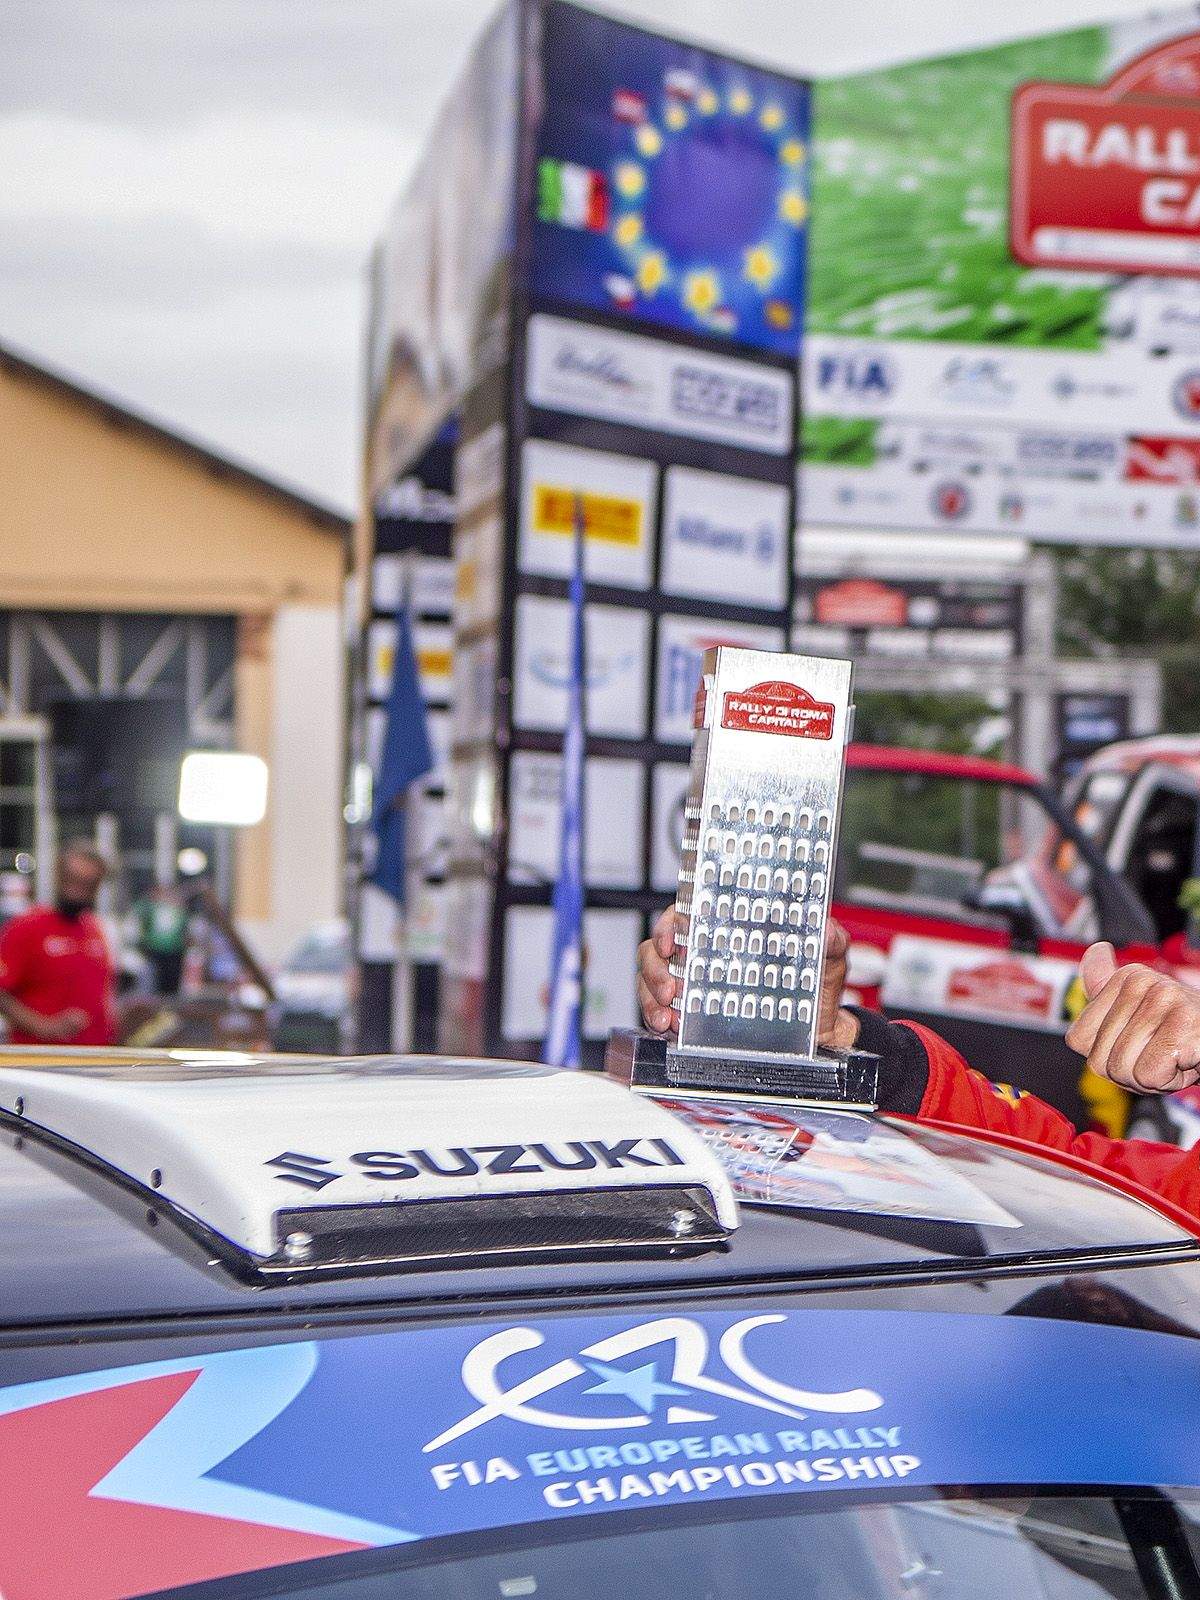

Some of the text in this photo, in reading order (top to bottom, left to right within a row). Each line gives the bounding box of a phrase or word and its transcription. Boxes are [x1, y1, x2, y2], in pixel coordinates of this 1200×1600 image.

[816, 354, 892, 398] FIA
[729, 701, 828, 720] RALLY DI ROMA
[749, 714, 808, 728] CAPITALE
[349, 1138, 685, 1181] SUZUKI
[430, 1425, 902, 1490] FIA EUROPEAN RALLY
[542, 1454, 922, 1509] CHAMPIONSHIP
